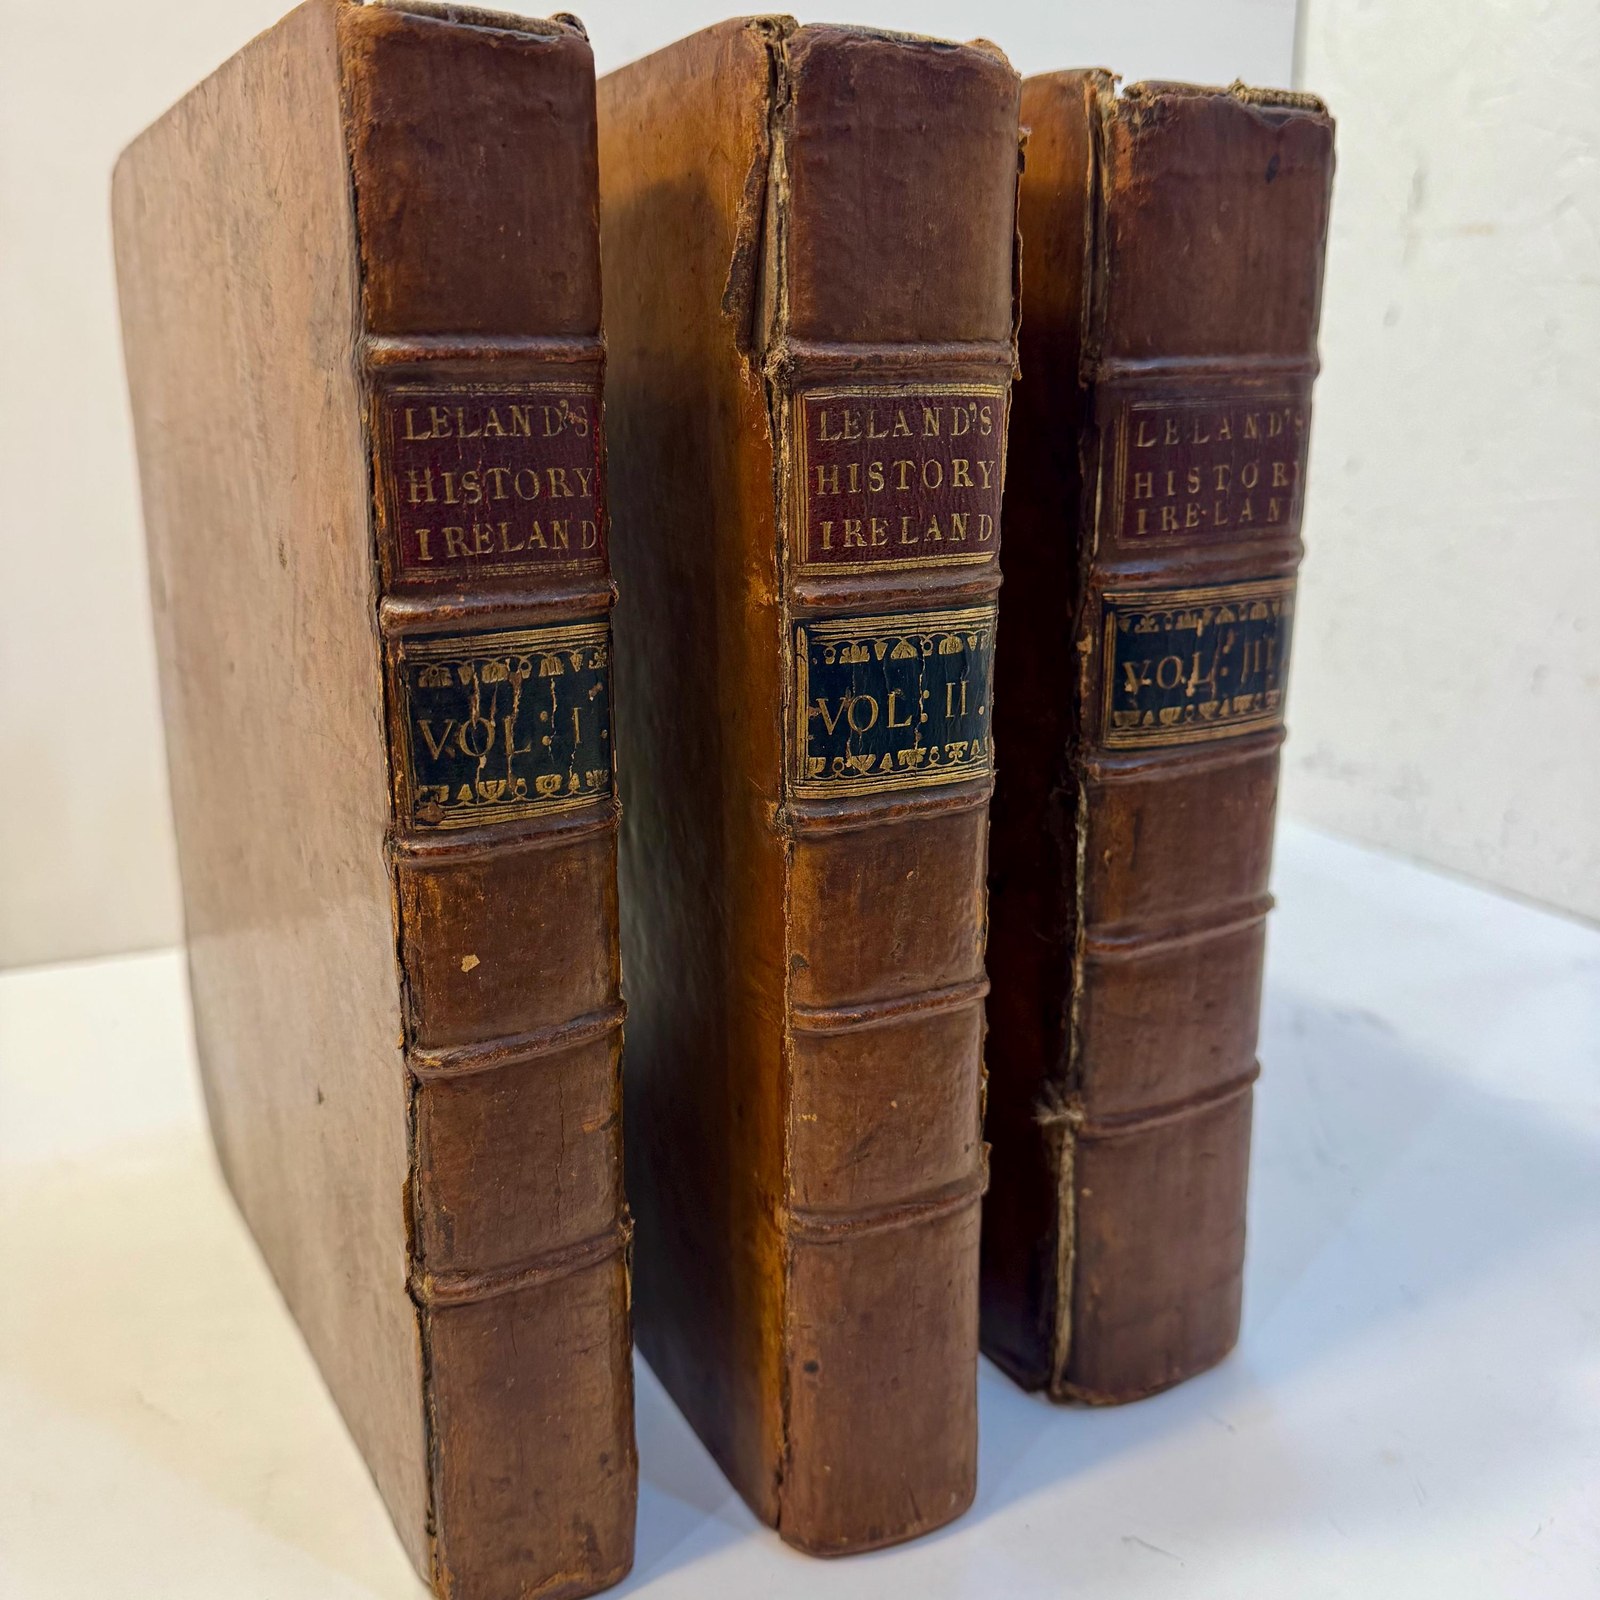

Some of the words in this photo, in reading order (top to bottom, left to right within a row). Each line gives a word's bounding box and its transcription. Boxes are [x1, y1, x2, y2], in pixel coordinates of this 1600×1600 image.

[402, 400, 590, 440] LELAND'S
[816, 402, 993, 441] LELAND'S
[406, 464, 594, 504] HISTORY
[816, 458, 996, 495] HISTORY
[819, 513, 994, 550] IRELAND
[1136, 497, 1288, 535] IRELAN
[414, 520, 598, 561] IRELAND
